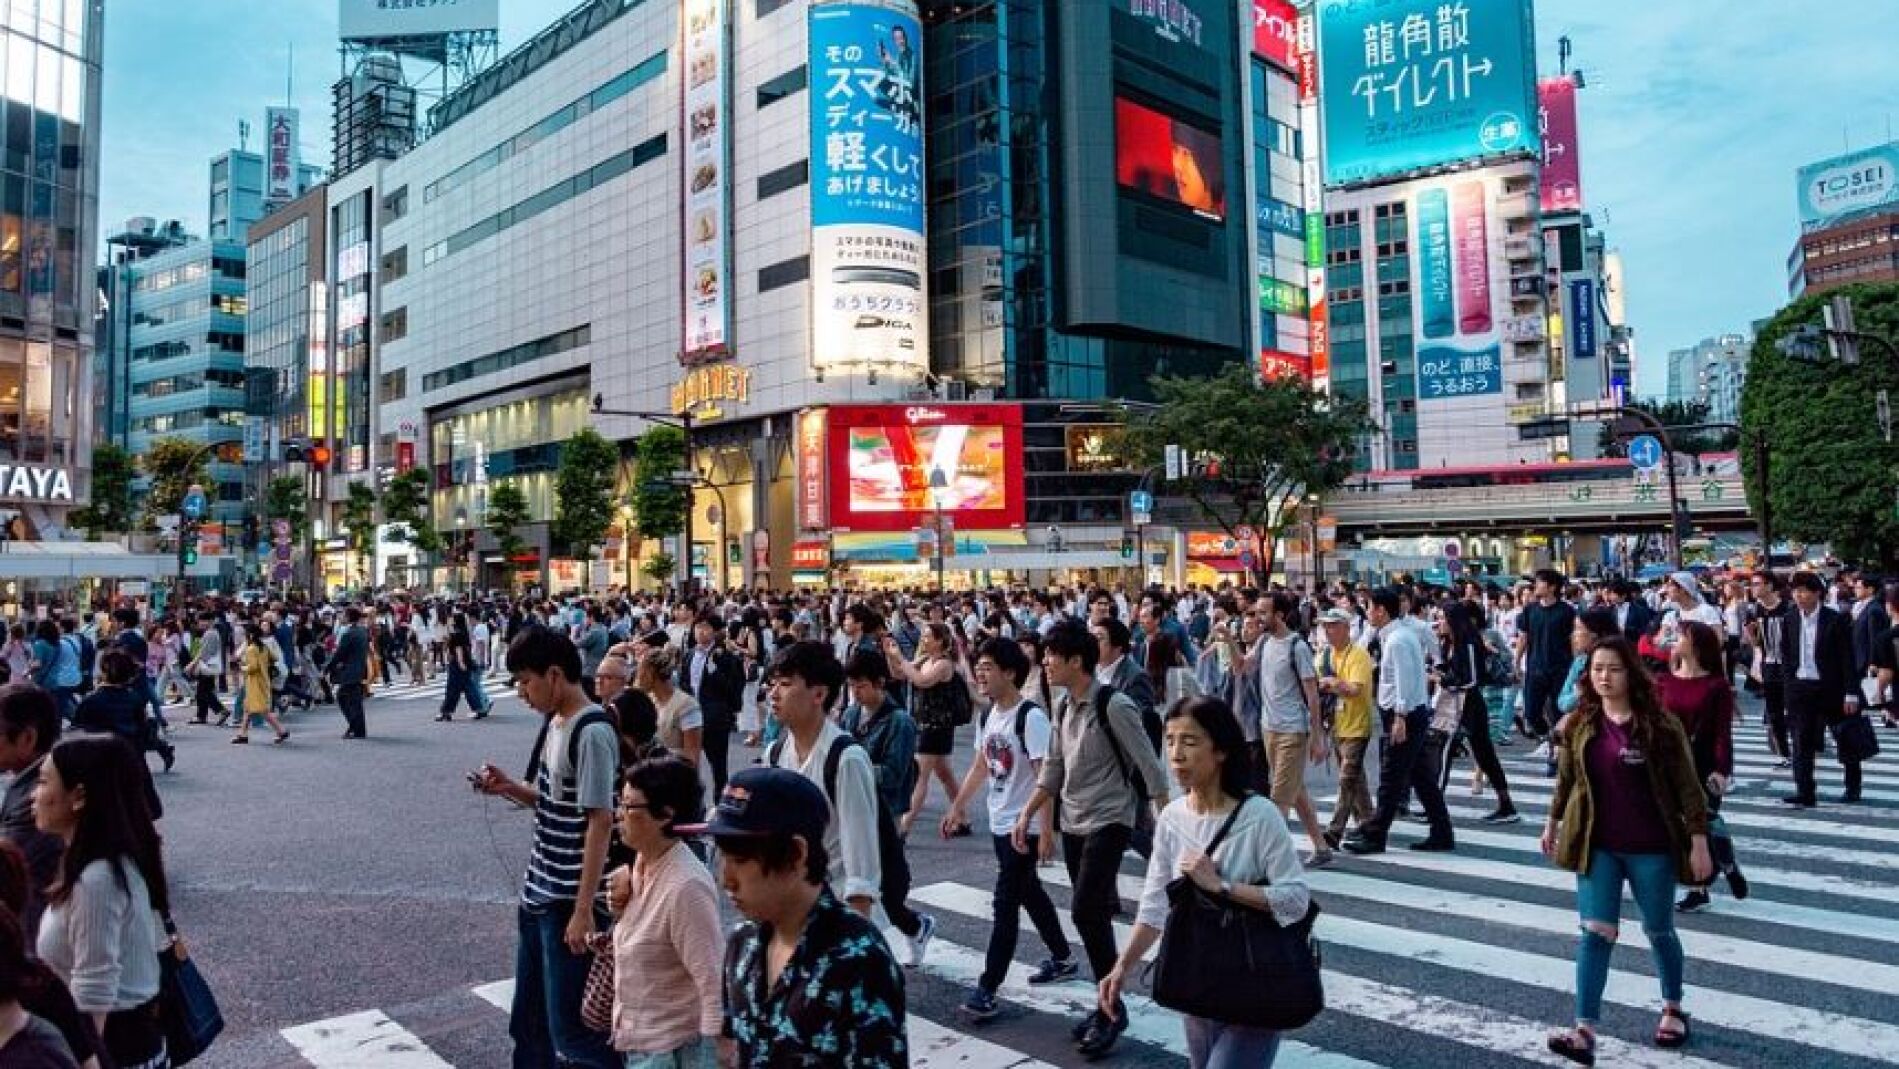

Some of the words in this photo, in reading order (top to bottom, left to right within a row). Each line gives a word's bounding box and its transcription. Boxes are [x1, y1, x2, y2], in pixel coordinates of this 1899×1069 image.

[1363, 3, 1470, 69] 龍角散
[825, 45, 862, 62] その
[825, 67, 913, 105] スマホ
[1352, 53, 1492, 118] ダイレクト
[826, 131, 921, 181] 軽くして
[827, 174, 919, 203] あげましょう
[1817, 165, 1885, 196] TOSEI
[1430, 376, 1488, 395] うるおう
